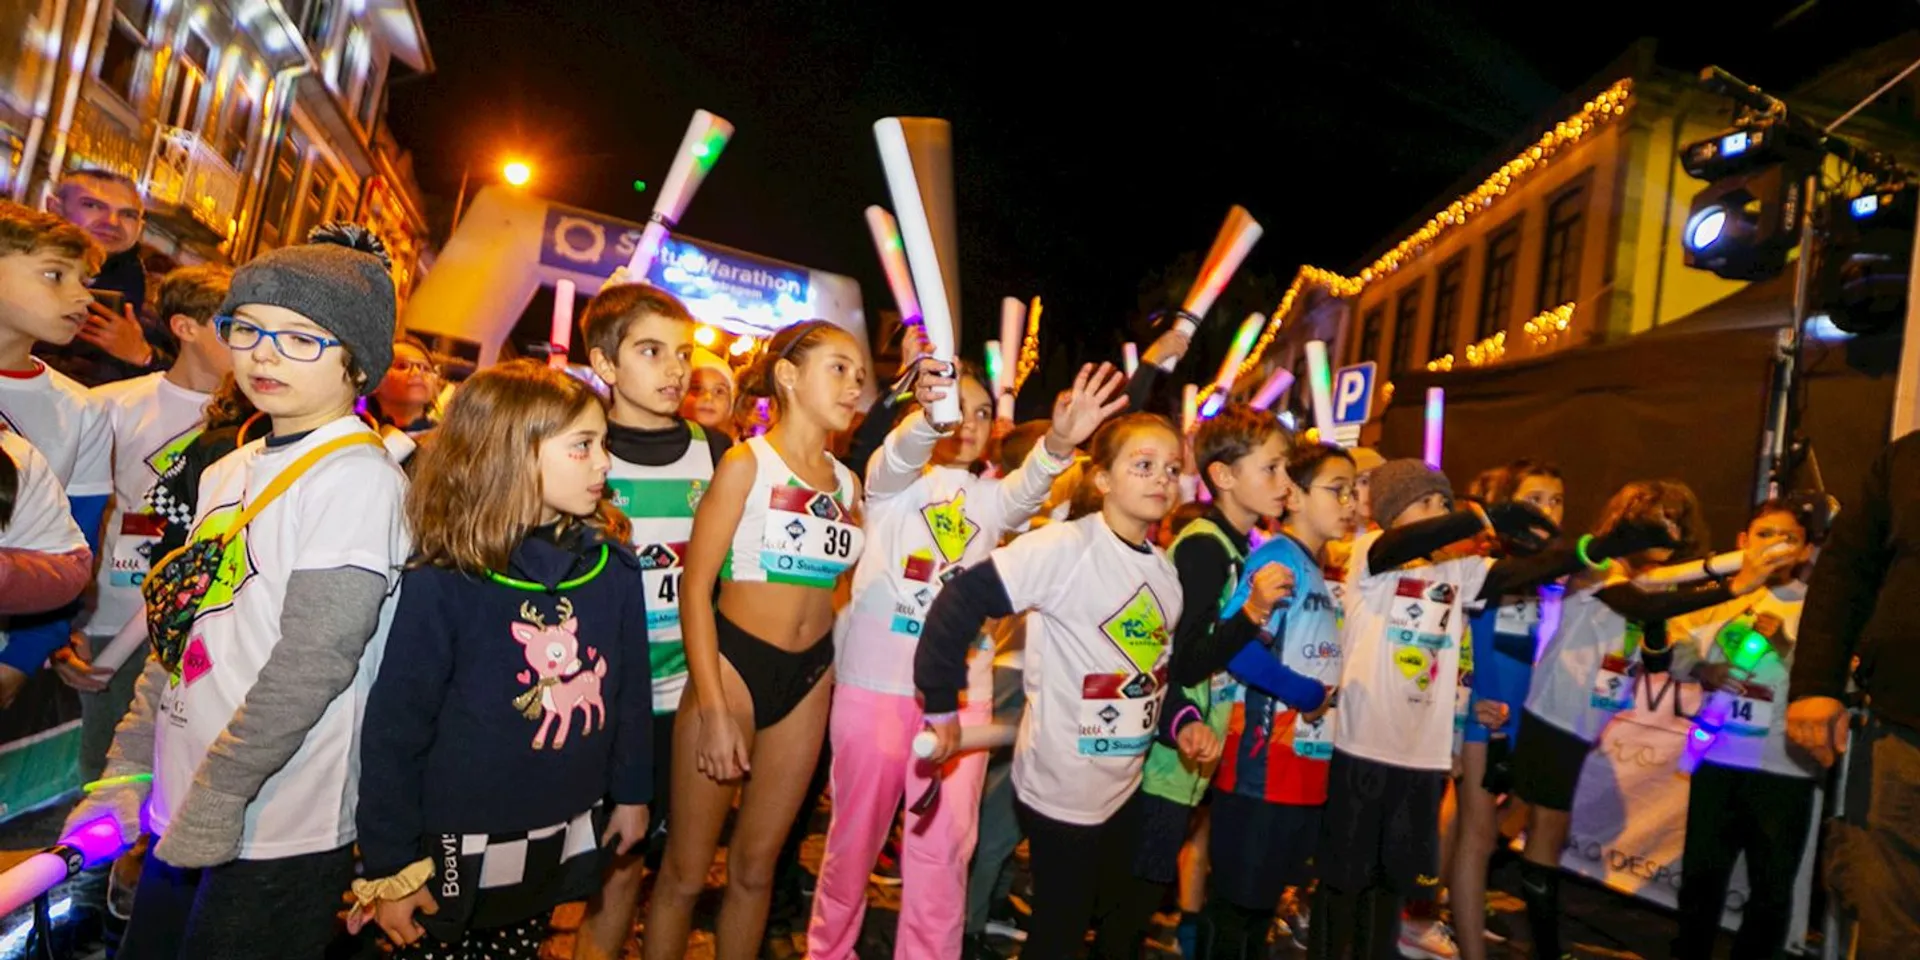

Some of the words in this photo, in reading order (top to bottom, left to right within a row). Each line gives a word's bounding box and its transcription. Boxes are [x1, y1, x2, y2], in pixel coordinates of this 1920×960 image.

[1336, 370, 1366, 420] P
[824, 525, 852, 558] 39
[658, 574, 681, 603] 4
[1732, 701, 1752, 721] 14
